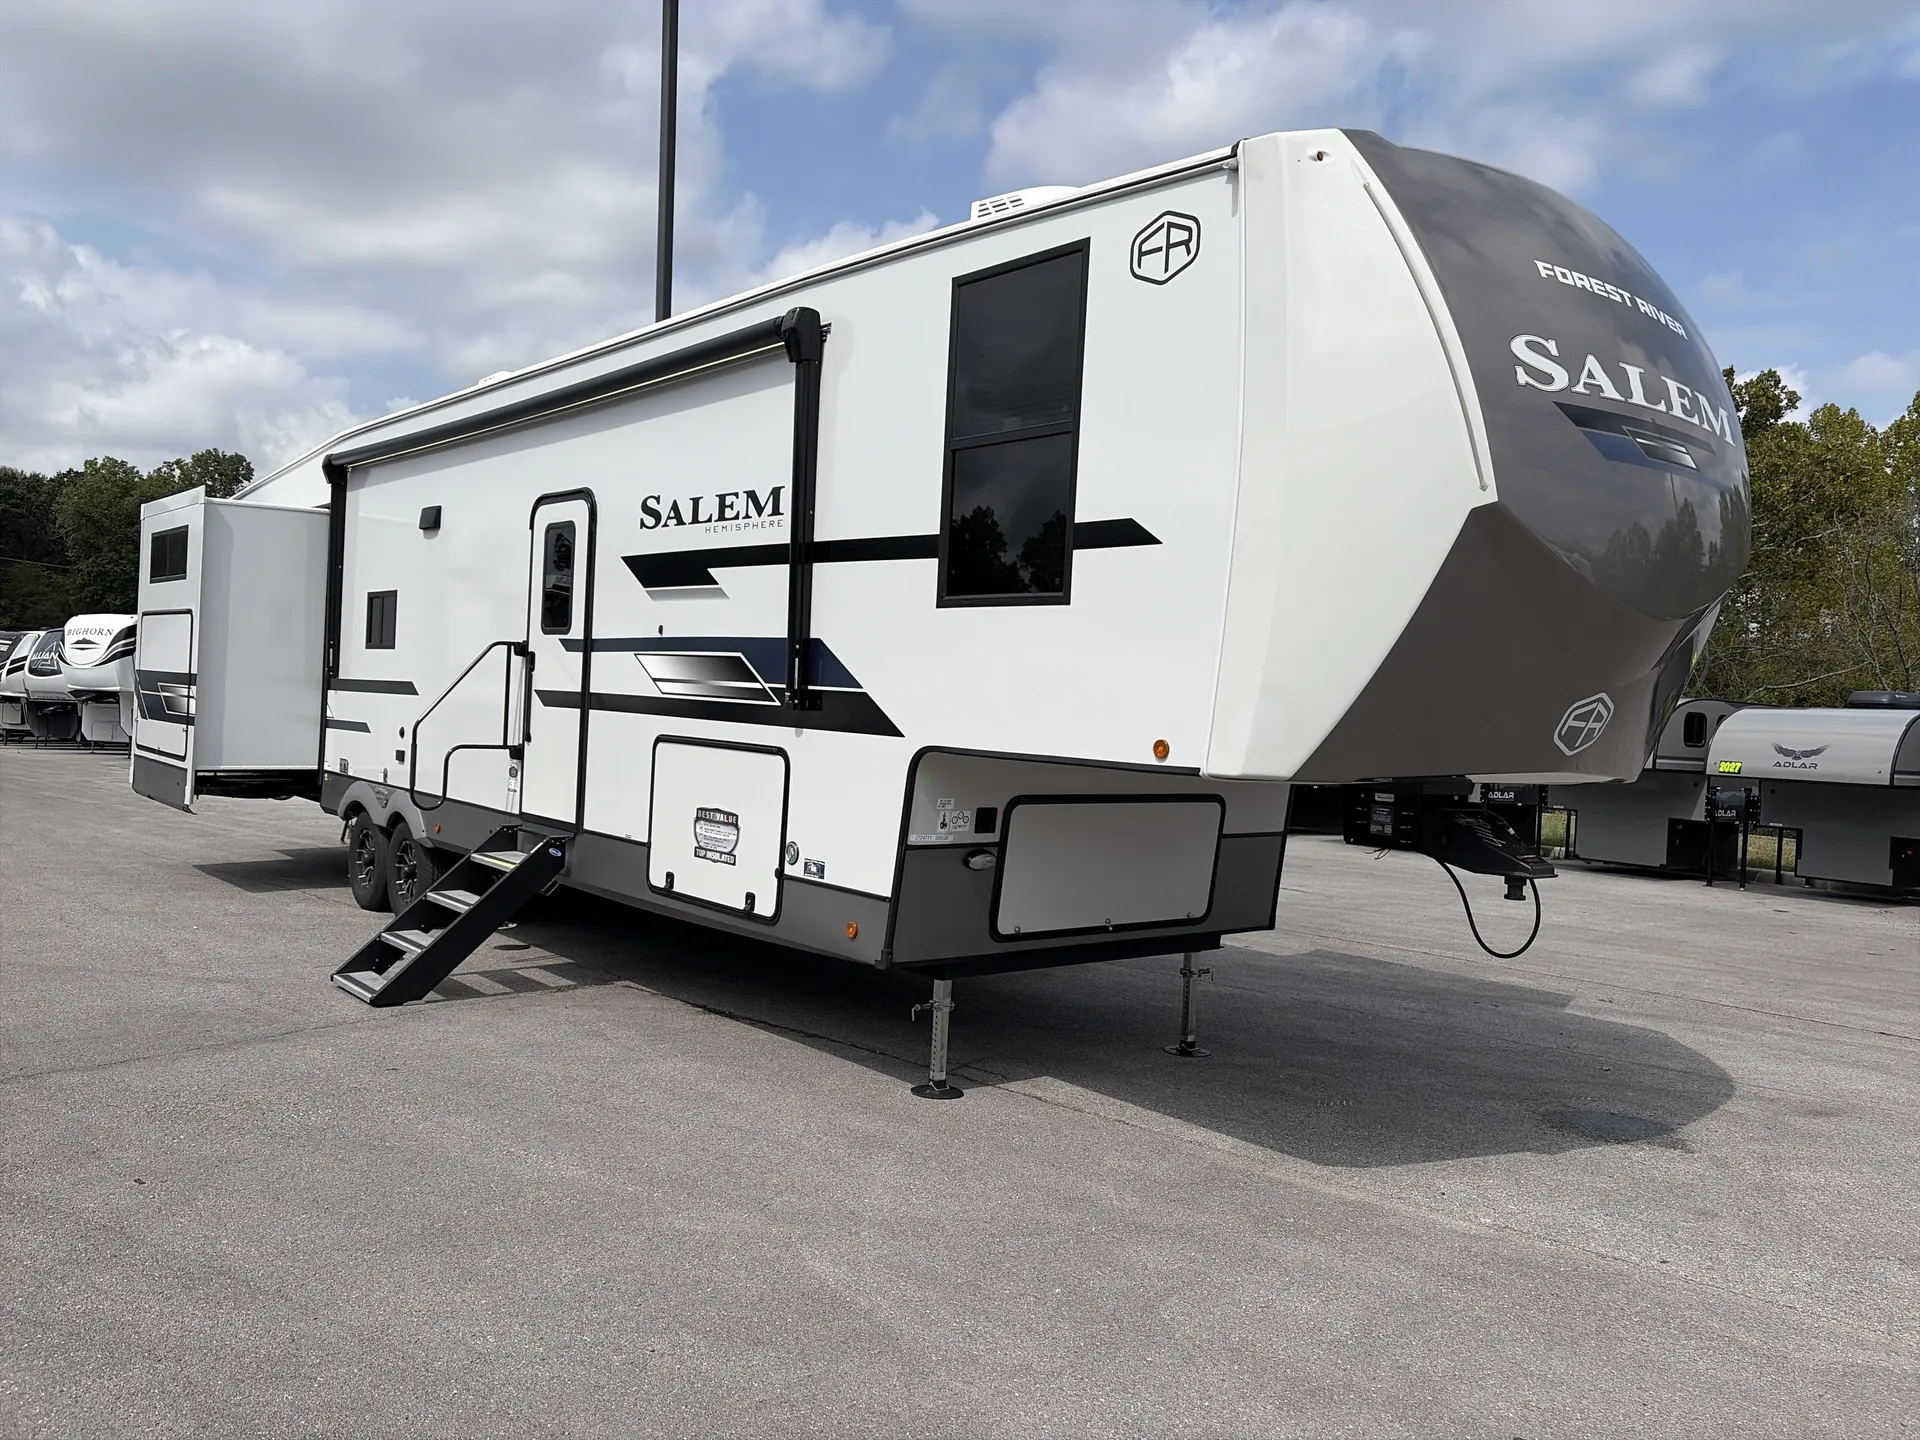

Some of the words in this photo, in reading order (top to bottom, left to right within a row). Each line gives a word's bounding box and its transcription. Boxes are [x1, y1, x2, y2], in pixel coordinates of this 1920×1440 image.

[1533, 259, 1633, 308] FOREST
[1633, 296, 1689, 341] RIVER
[1509, 333, 1737, 448] SALEM
[639, 485, 786, 530] SALEM
[704, 519, 784, 534] HEMISPHERE
[66, 627, 114, 637] BIGHORN
[31, 651, 59, 661] ALLIAN
[1718, 761, 1743, 773] 2027
[1772, 760, 1819, 770] ADLAR
[1488, 791, 1515, 799] ADLAR
[697, 809, 714, 820] BEST
[715, 812, 737, 824] VALUE
[706, 850, 735, 864] INSULATED
